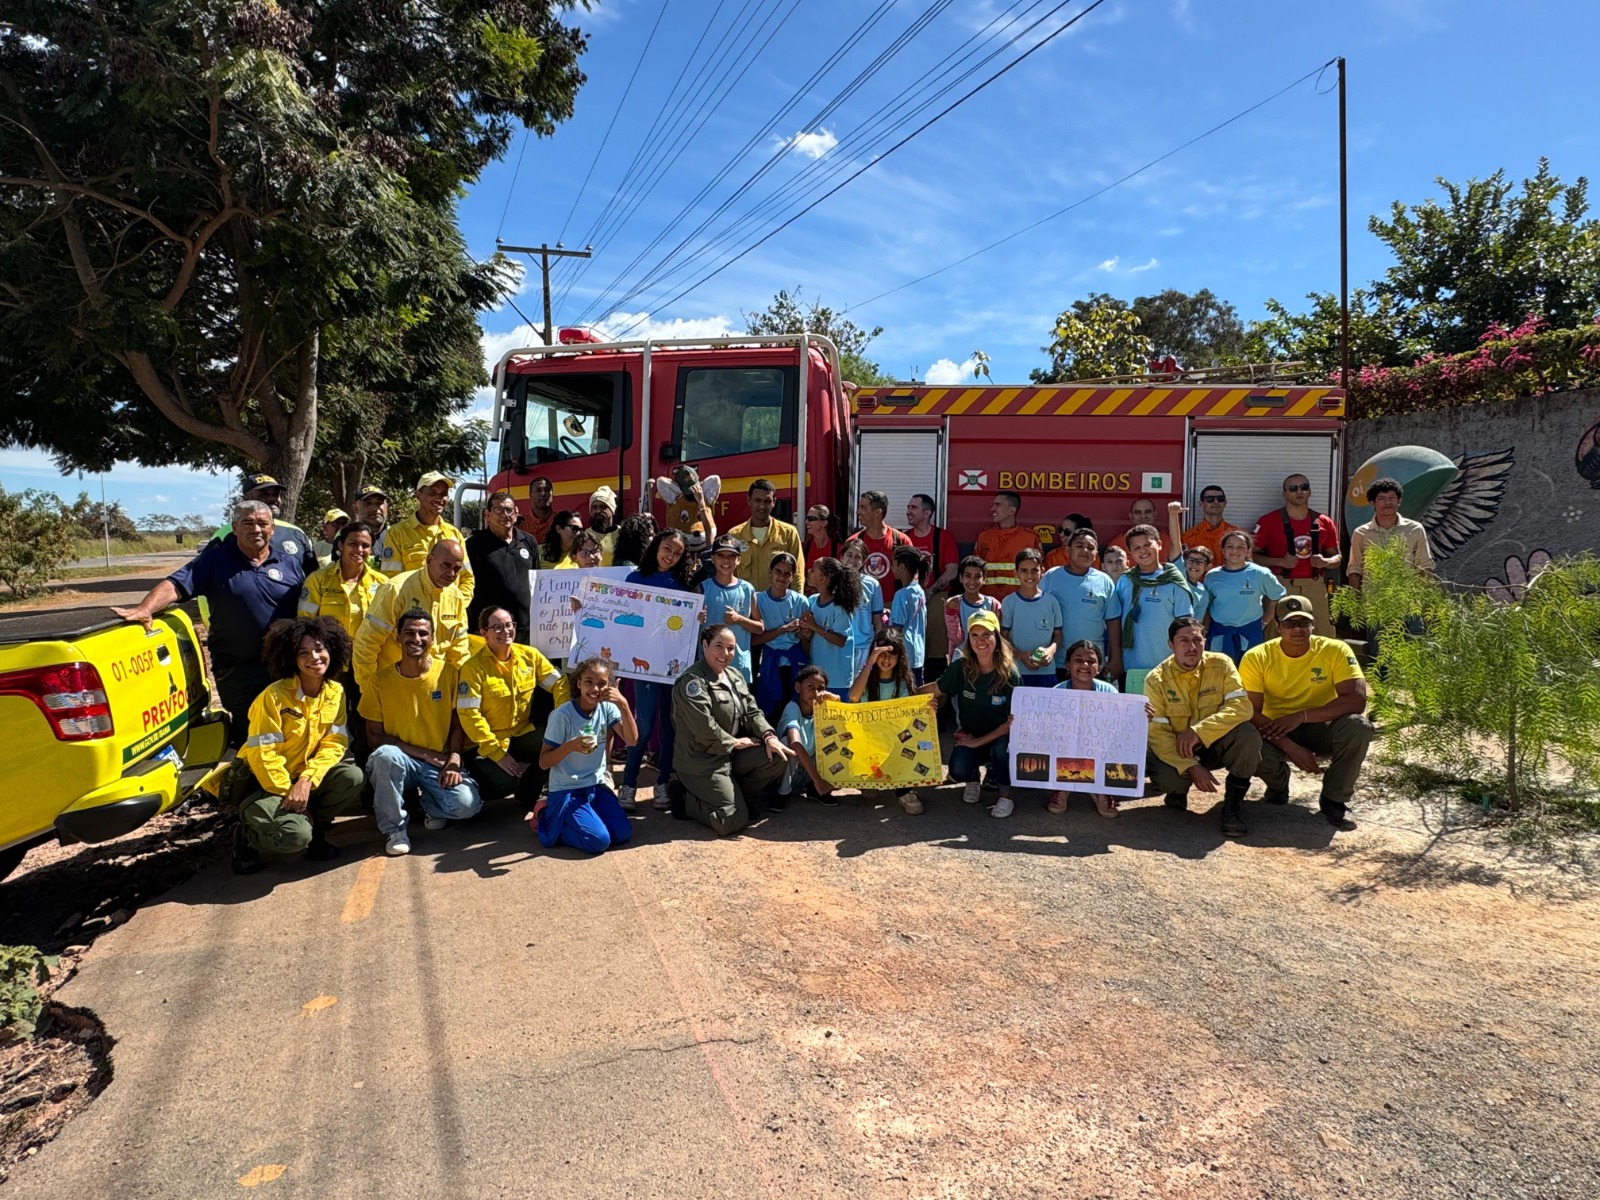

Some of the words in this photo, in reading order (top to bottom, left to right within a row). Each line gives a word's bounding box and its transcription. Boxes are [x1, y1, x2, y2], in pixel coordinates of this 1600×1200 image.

[998, 471, 1131, 491] BOMBEIROS
[1352, 480, 1365, 497] oi
[550, 578, 580, 595] temp
[540, 591, 553, 604] de
[547, 604, 573, 623] pla
[540, 620, 558, 631] não
[562, 621, 575, 634] po
[549, 635, 572, 649] esp
[1059, 698, 1121, 715] COMBATA
[1125, 703, 1135, 717] E
